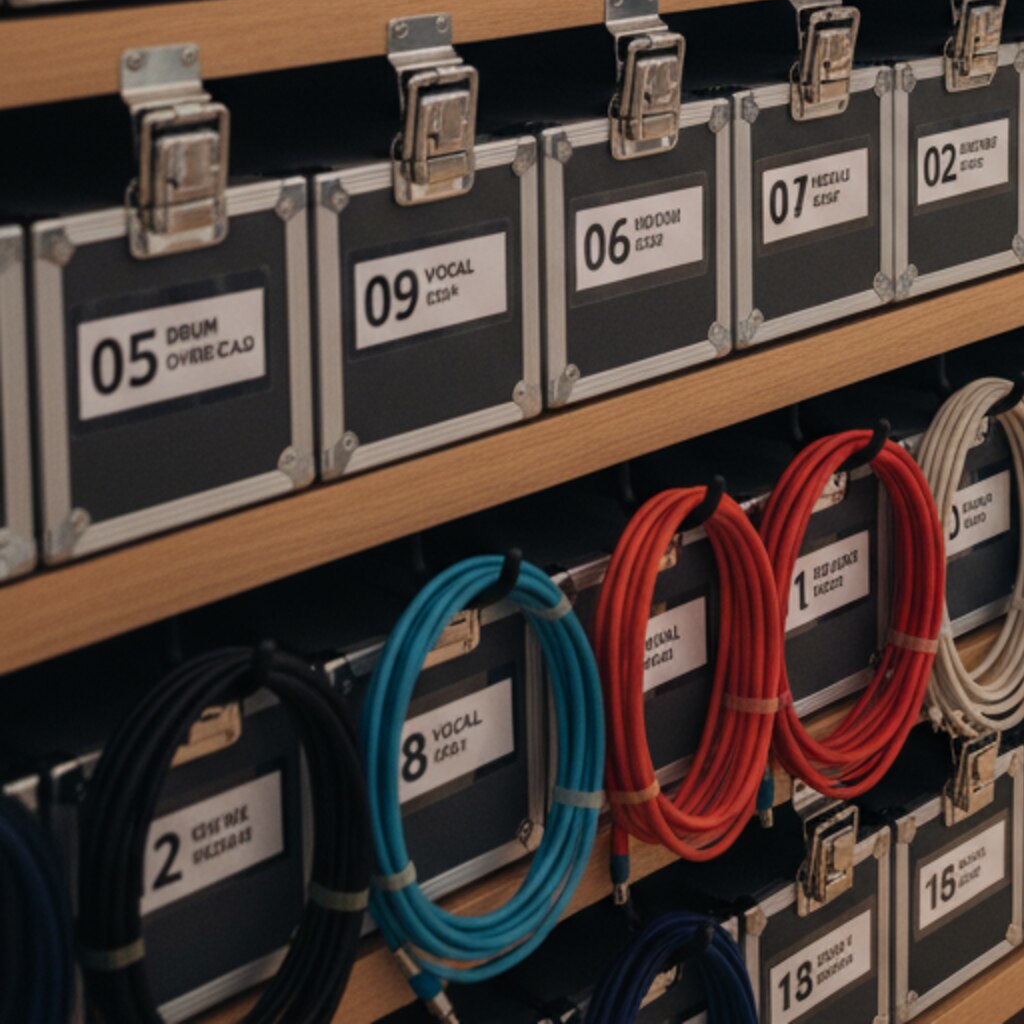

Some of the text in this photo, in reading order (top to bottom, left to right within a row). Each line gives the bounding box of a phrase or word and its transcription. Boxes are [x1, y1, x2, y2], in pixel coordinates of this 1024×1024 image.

[923, 143, 958, 187] 02
[769, 174, 809, 225] 07
[583, 217, 631, 272] 06
[423, 258, 475, 284] VOCAL
[364, 268, 419, 328] 09
[91, 328, 159, 396] 05
[793, 570, 809, 612] 1
[432, 709, 484, 743] VOCAL
[400, 731, 428, 783] 8
[153, 831, 183, 891] 2
